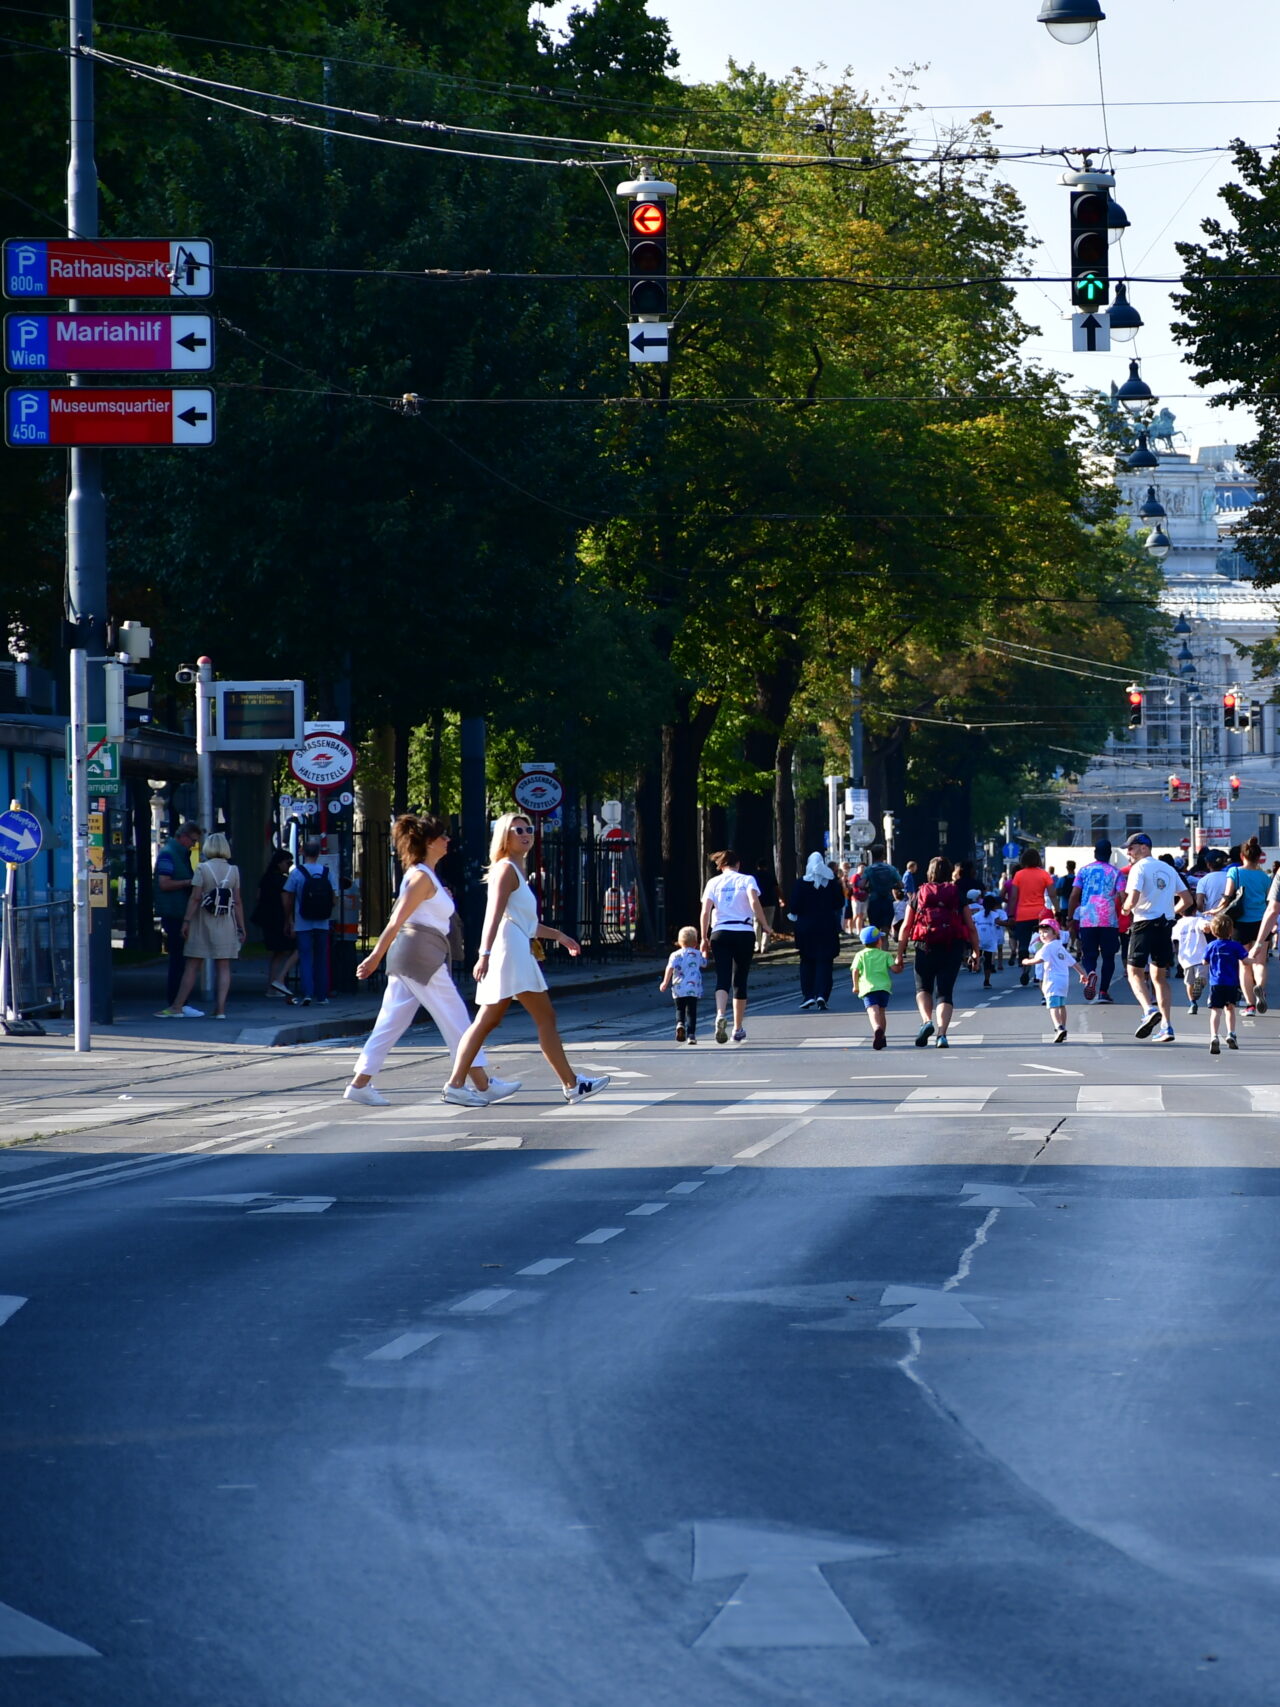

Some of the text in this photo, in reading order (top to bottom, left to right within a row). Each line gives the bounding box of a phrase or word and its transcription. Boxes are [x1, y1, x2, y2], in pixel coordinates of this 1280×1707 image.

[51, 259, 166, 281] Rathauspark
[56, 321, 162, 341] Mariahilf
[12, 351, 46, 366] Wien
[51, 398, 170, 414] Museumsquartier
[296, 740, 349, 758] STRASSENBAHN
[298, 766, 347, 782] HALTESTELLE
[87, 783, 119, 793] amping
[578, 1081, 593, 1095] N
